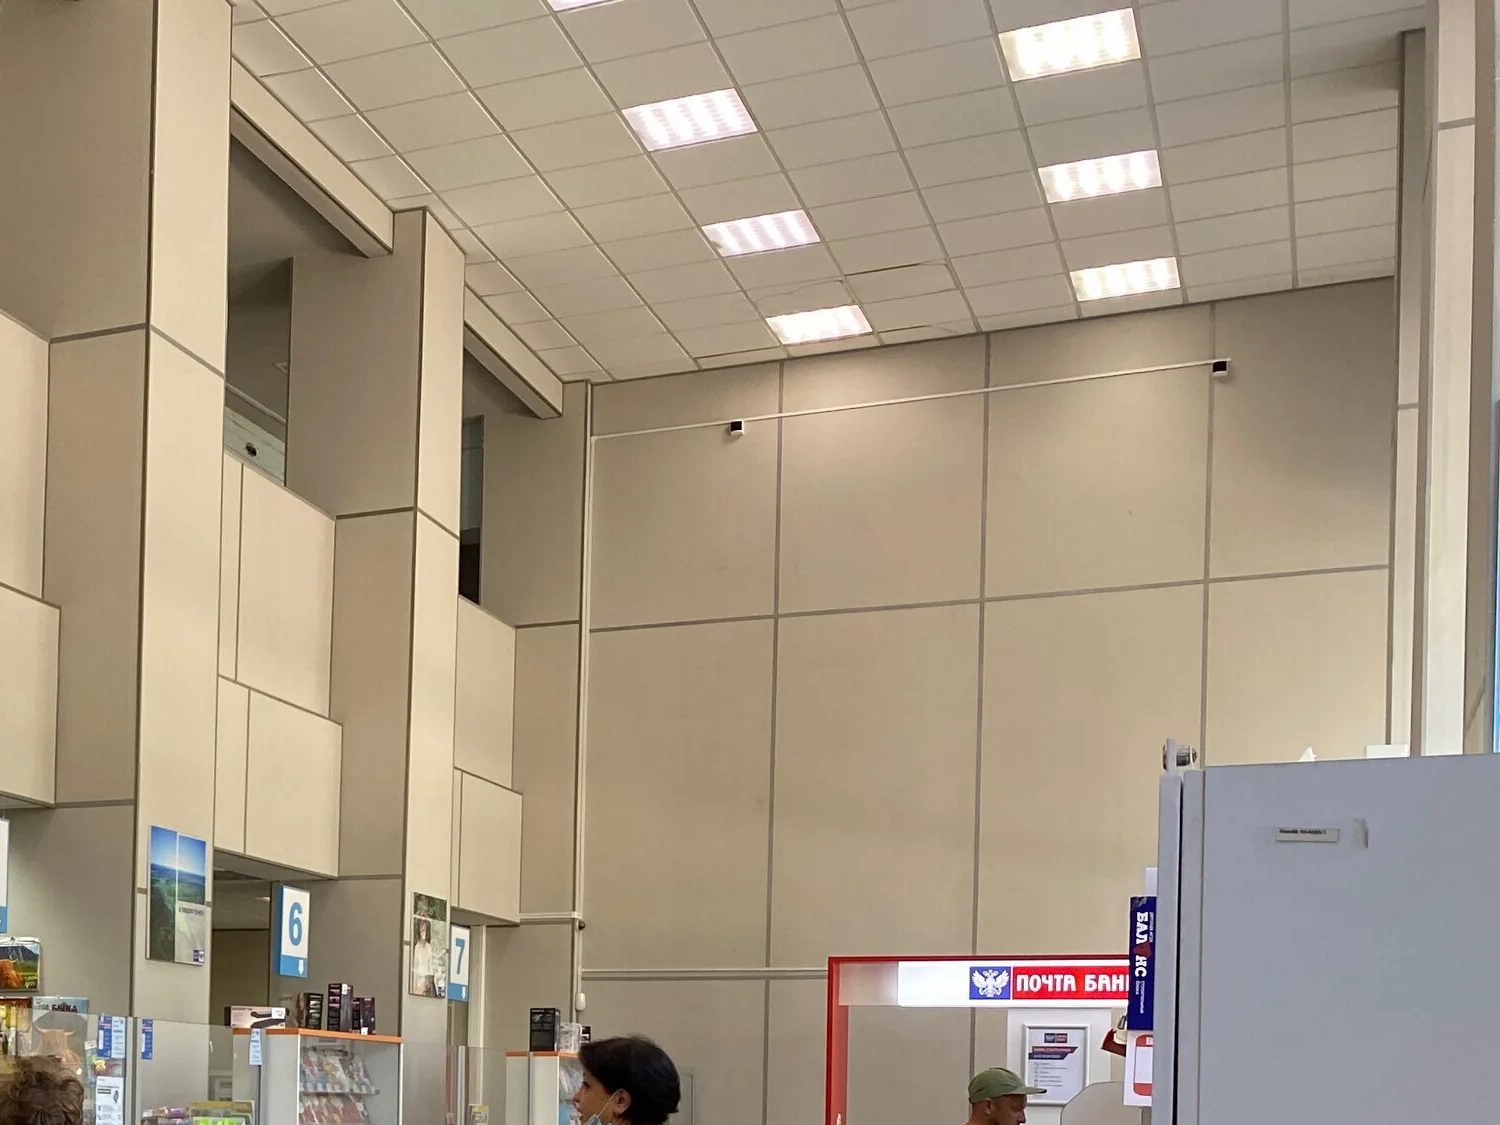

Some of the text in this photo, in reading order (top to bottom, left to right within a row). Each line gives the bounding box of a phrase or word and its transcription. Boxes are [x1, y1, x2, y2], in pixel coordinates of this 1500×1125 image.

[288, 902, 303, 946] 6
[455, 938, 465, 975] 7
[1016, 974, 1129, 992] ПОЧТА БАН
